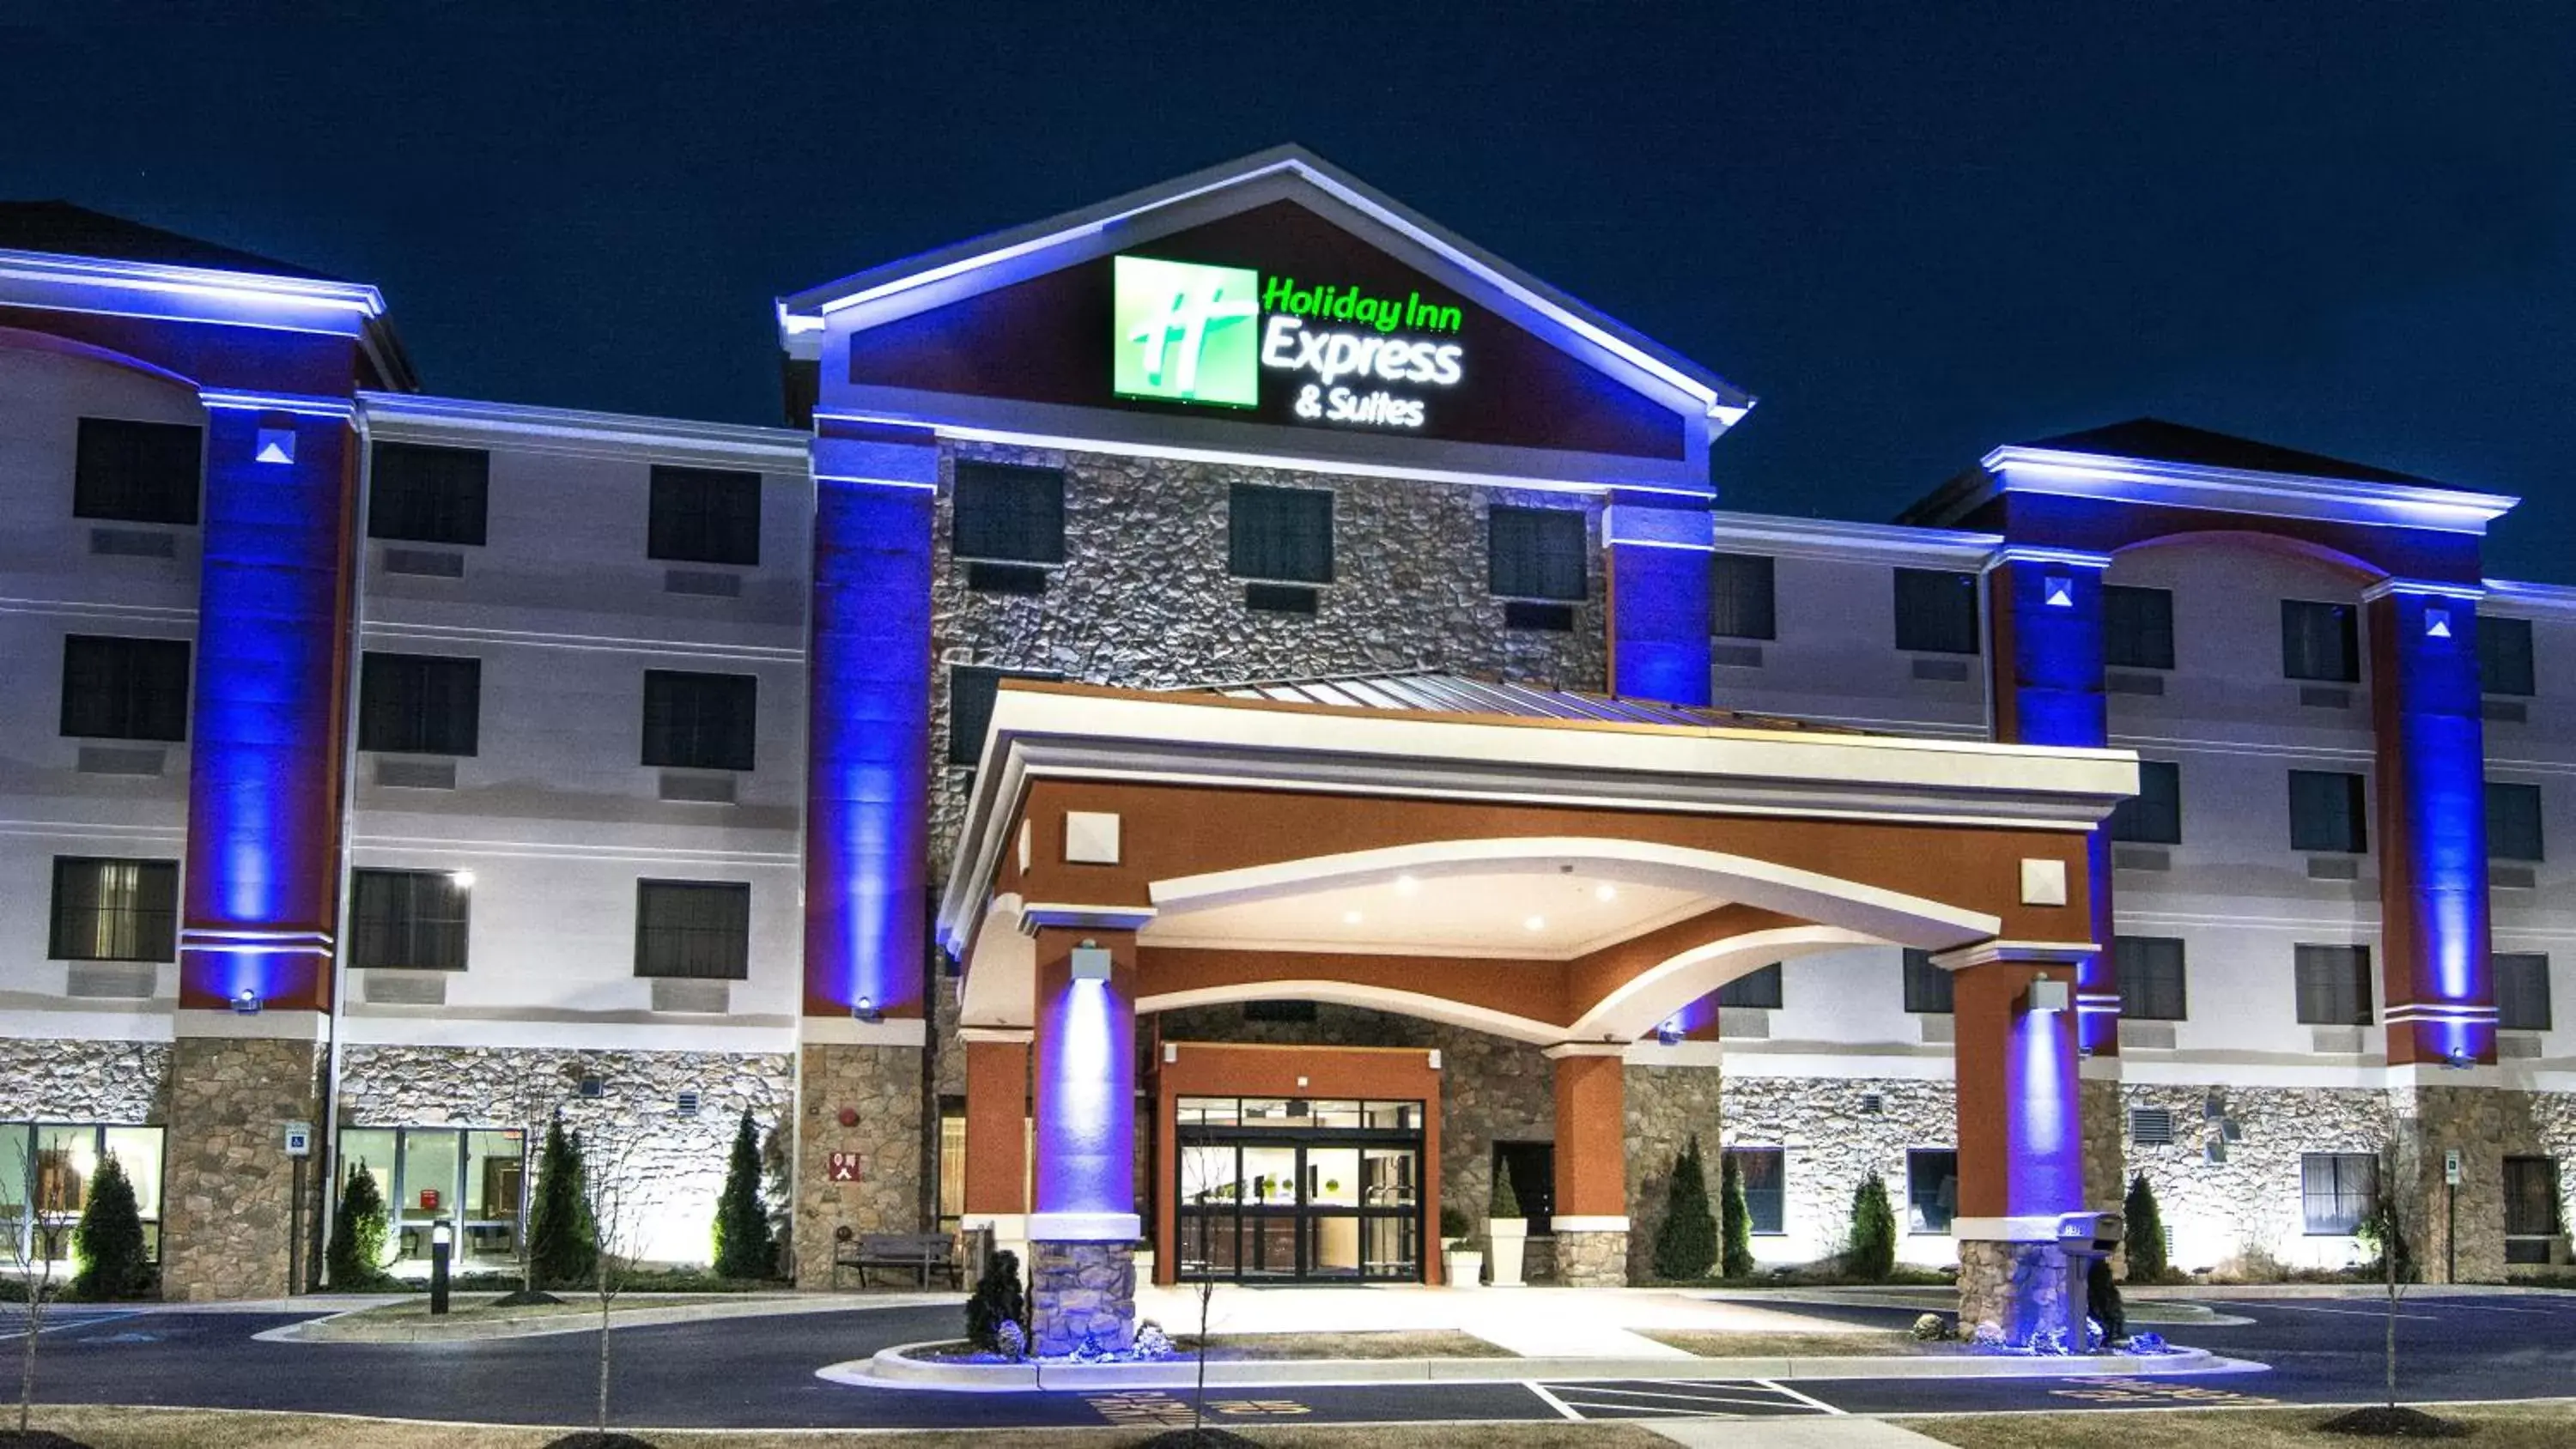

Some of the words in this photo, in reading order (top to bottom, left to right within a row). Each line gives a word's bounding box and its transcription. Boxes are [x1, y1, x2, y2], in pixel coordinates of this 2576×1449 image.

[1264, 276, 1401, 332] Holiday
[1407, 291, 1461, 330] Inn
[1261, 315, 1463, 385] Express
[1295, 384, 1321, 419] &
[1327, 387, 1425, 427] Suites
